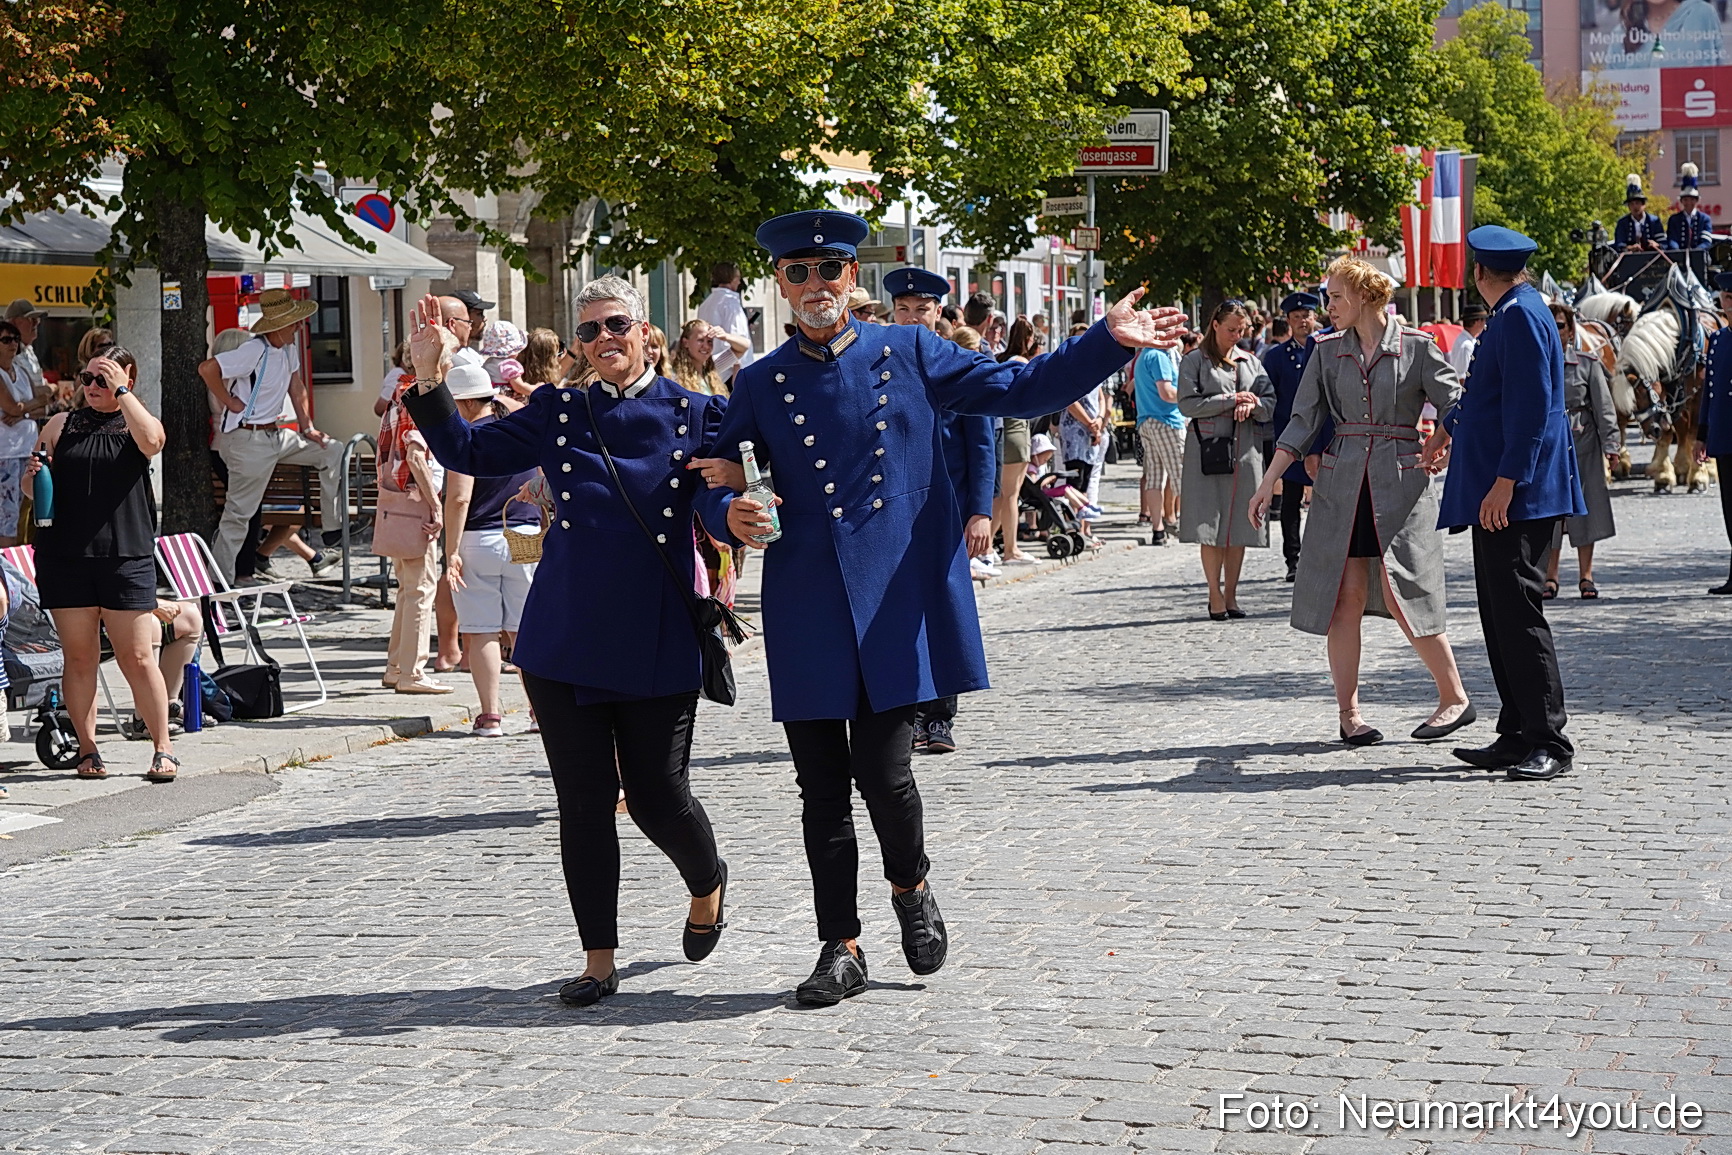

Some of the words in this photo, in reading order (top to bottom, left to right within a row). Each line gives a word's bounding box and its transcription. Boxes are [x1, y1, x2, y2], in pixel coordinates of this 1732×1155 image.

[1589, 31, 1626, 46] Mehr
[1589, 50, 1647, 66] Weniger
[1652, 48, 1731, 62] ackgasse.
[1077, 149, 1138, 164] Rosengasse
[1045, 200, 1084, 213] Rosengasse
[34, 285, 99, 304] SCHLI
